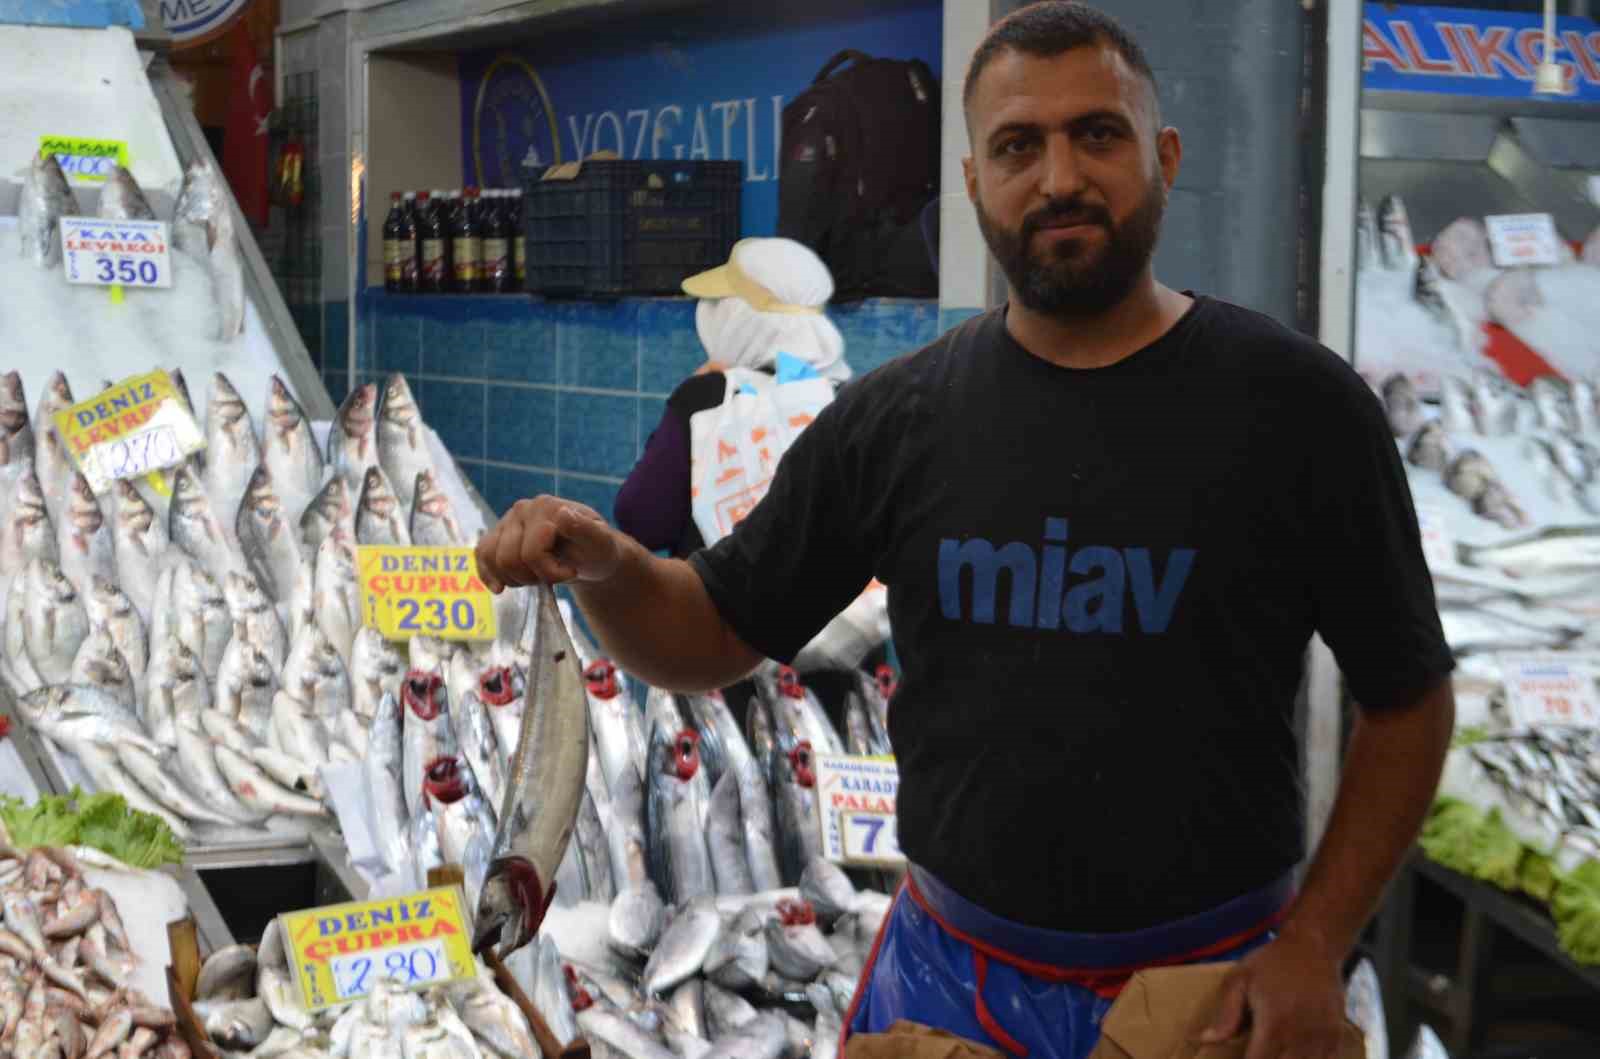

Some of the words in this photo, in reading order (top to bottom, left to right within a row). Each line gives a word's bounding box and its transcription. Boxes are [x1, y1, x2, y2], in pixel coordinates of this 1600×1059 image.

[568, 95, 784, 181] YOZGATLI
[80, 228, 149, 242] KAYA
[95, 257, 159, 284] 350
[72, 400, 162, 454] LEVRE
[381, 552, 469, 572] DENİZ
[937, 516, 1197, 633] miav
[367, 574, 487, 597] ÇUPRA
[396, 597, 475, 630] 230
[831, 793, 897, 815] PALA
[851, 816, 897, 853] 7
[317, 897, 434, 938] DENİZ
[304, 918, 458, 966] ÇUPRA
